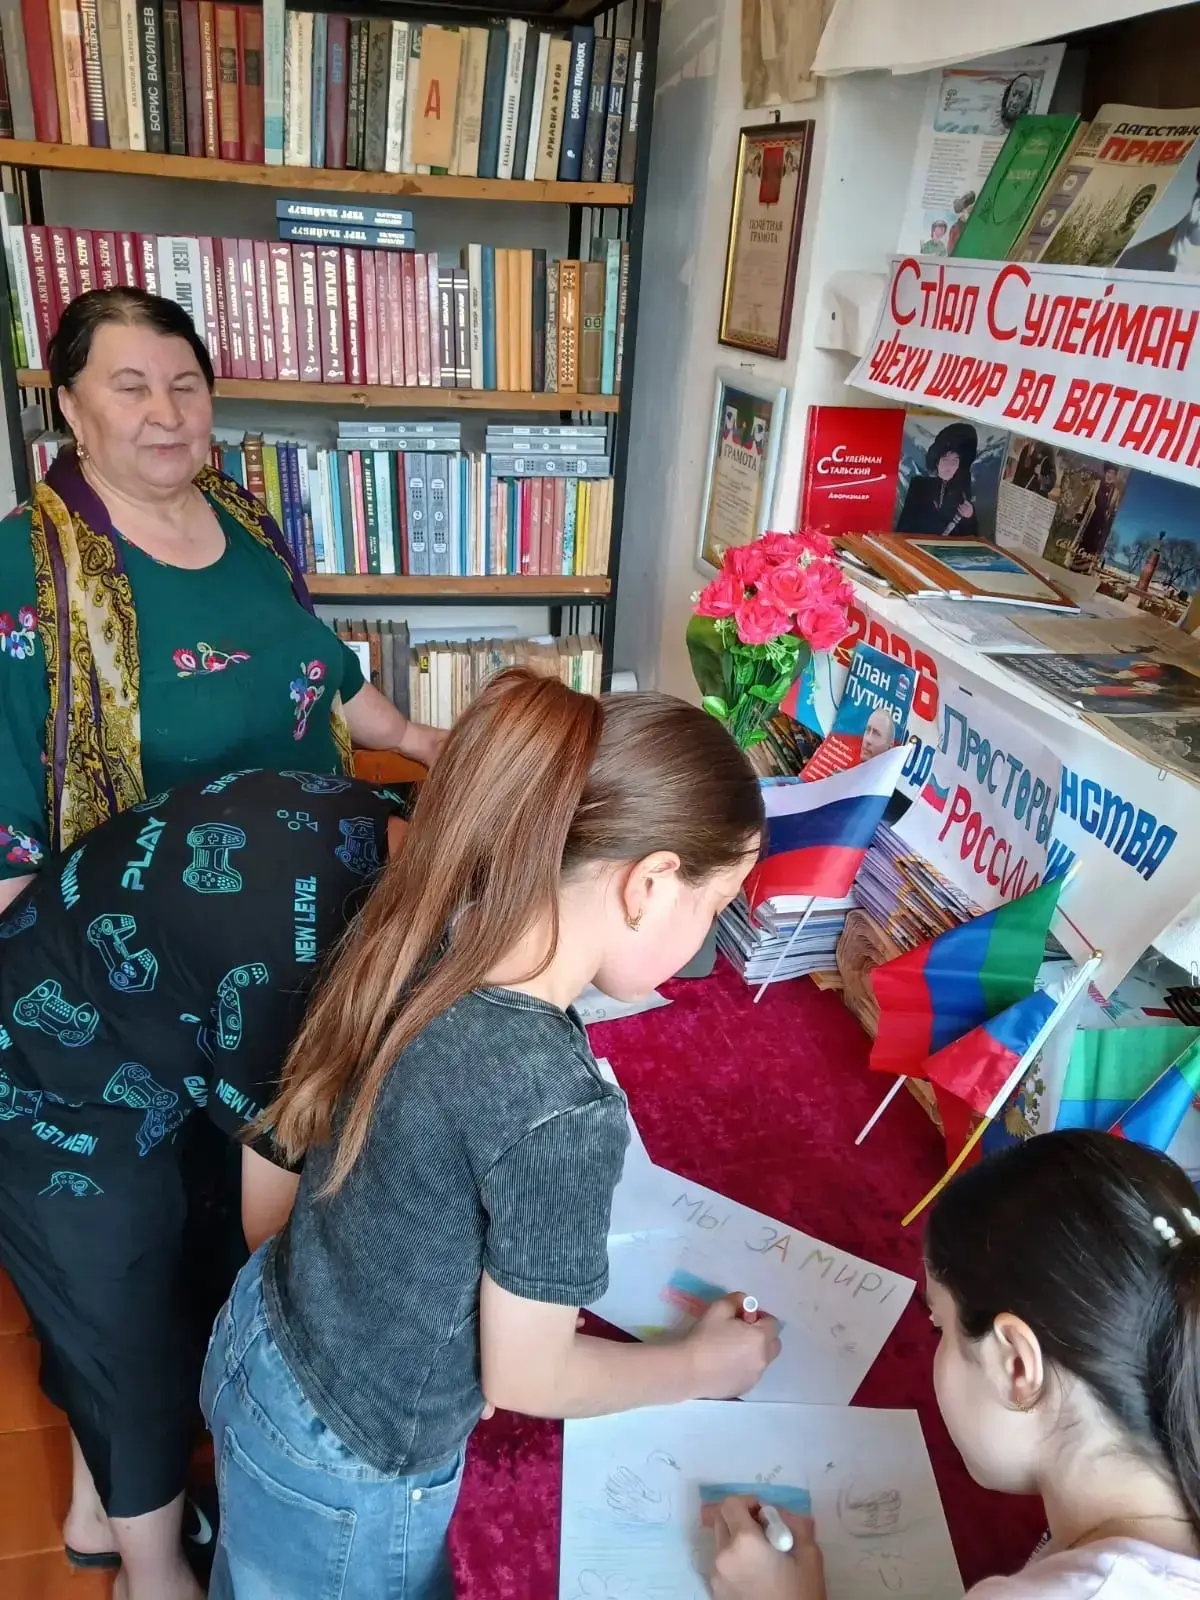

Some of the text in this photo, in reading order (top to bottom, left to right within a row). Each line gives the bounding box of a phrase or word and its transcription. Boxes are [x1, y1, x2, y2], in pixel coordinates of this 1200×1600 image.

[90, 9, 100, 60] АНДЕРСЕН
[143, 6, 161, 132] БОРИС ВАСИЛЬЕВ
[571, 41, 587, 120] БОРИС ПИЛЬНЯК
[424, 79, 441, 121] А
[546, 63, 562, 159] АРИАДНА ЭФРОН
[31, 233, 44, 263] ЭСЕРАР
[53, 234, 66, 264] ЭСЕРАР
[76, 236, 88, 266] ЭСЕРАР
[99, 238, 111, 267] ЭСЕРАР
[144, 240, 155, 269] ЭСЕРАР
[749, 231, 779, 244] ГРАМОТА
[923, 352, 1008, 408] ШАИР
[1002, 368, 1056, 425] ВА
[723, 443, 757, 472] ГРАМОТА
[850, 653, 892, 691] План
[845, 674, 903, 725] Путина
[1058, 765, 1178, 882] НСТВА
[120, 816, 168, 891] PLAY
[294, 875, 318, 964] NEW LEVEL
[215, 1078, 248, 1114] NEW
[31, 1120, 100, 1157] NEW LEV
[672, 1192, 731, 1230] МЫ
[744, 1226, 791, 1263] ЗА
